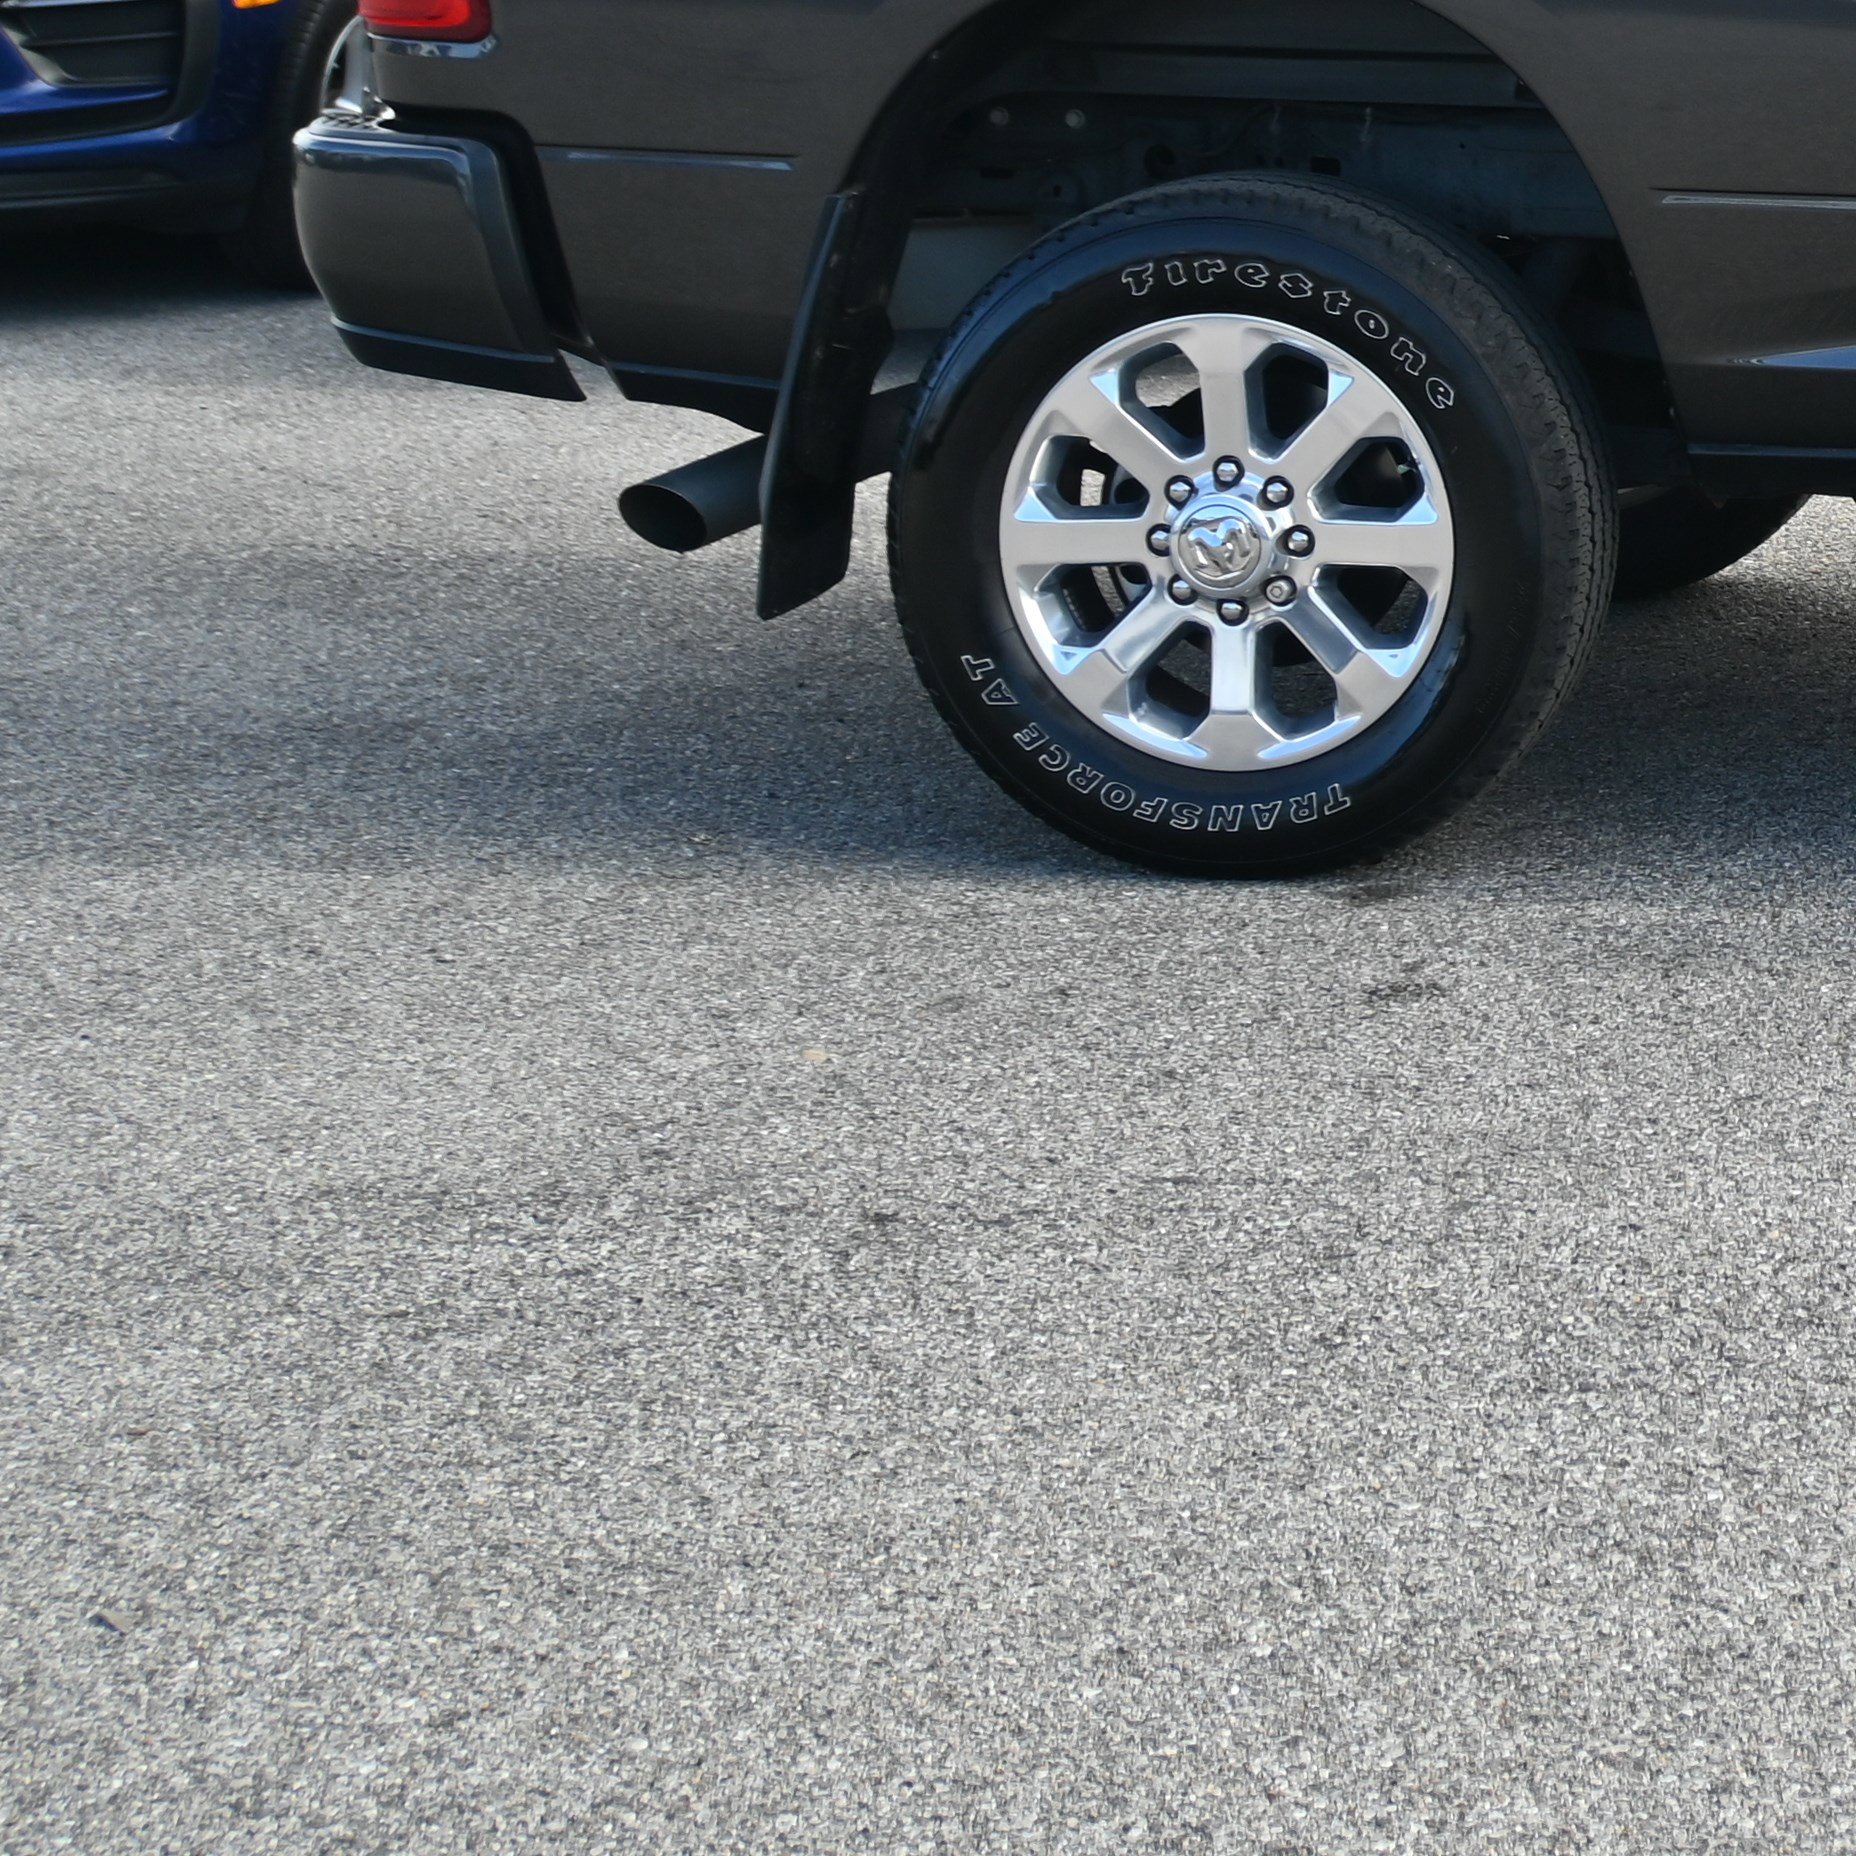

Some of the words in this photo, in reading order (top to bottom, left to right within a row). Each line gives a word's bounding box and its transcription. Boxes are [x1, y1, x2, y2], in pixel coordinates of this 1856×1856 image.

[1121, 258, 1455, 411] Firestone
[960, 654, 1019, 706] AT
[1012, 721, 1353, 833] TRANSFORCE
